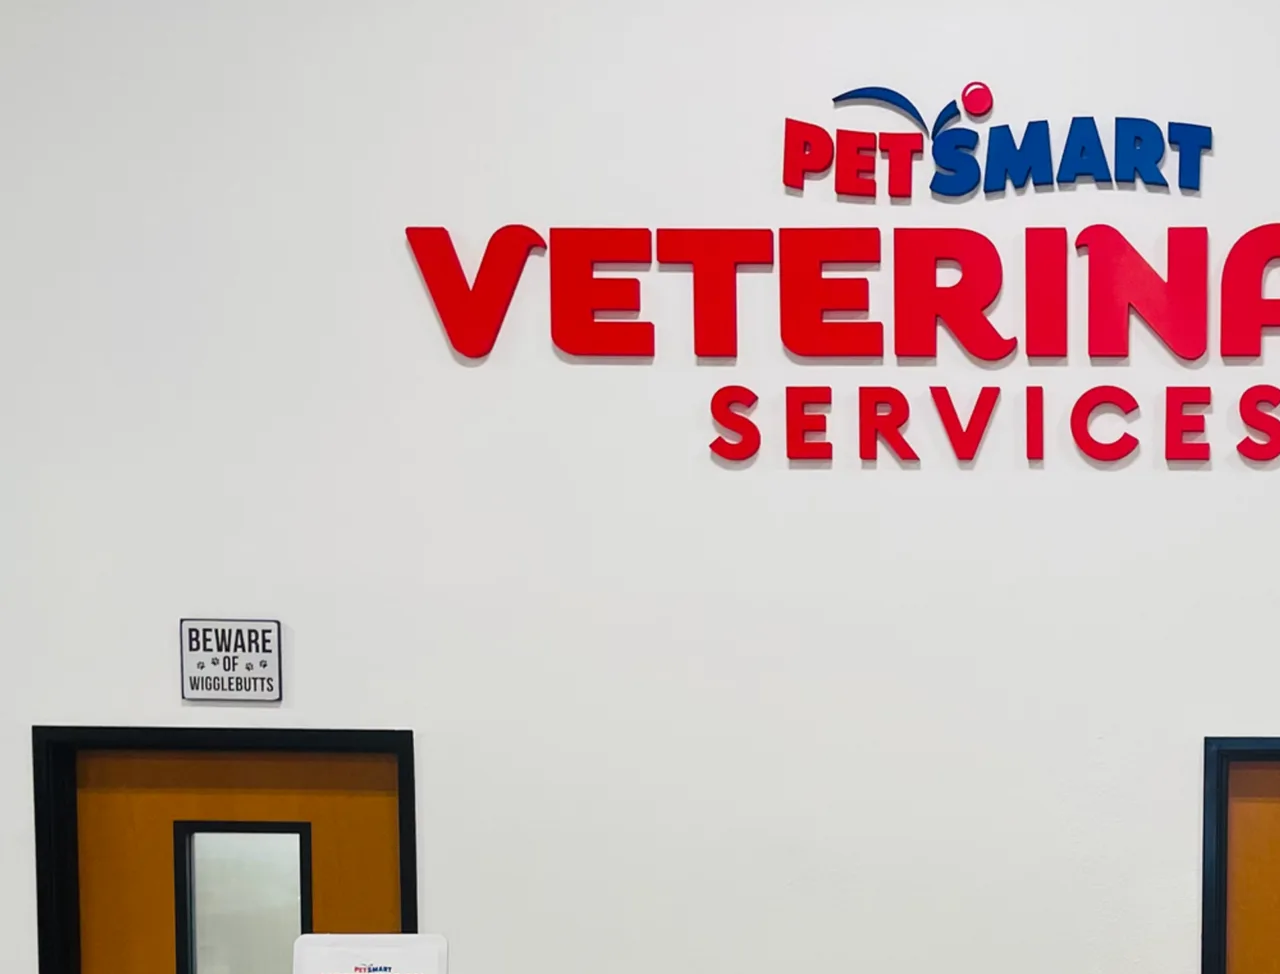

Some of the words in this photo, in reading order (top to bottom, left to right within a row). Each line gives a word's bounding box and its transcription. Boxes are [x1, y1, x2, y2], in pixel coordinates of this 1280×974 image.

[783, 116, 1214, 201] PETSMART
[188, 628, 272, 653] BEWARE
[222, 655, 239, 672] OF
[189, 676, 274, 692] WIGGLEBUTTS
